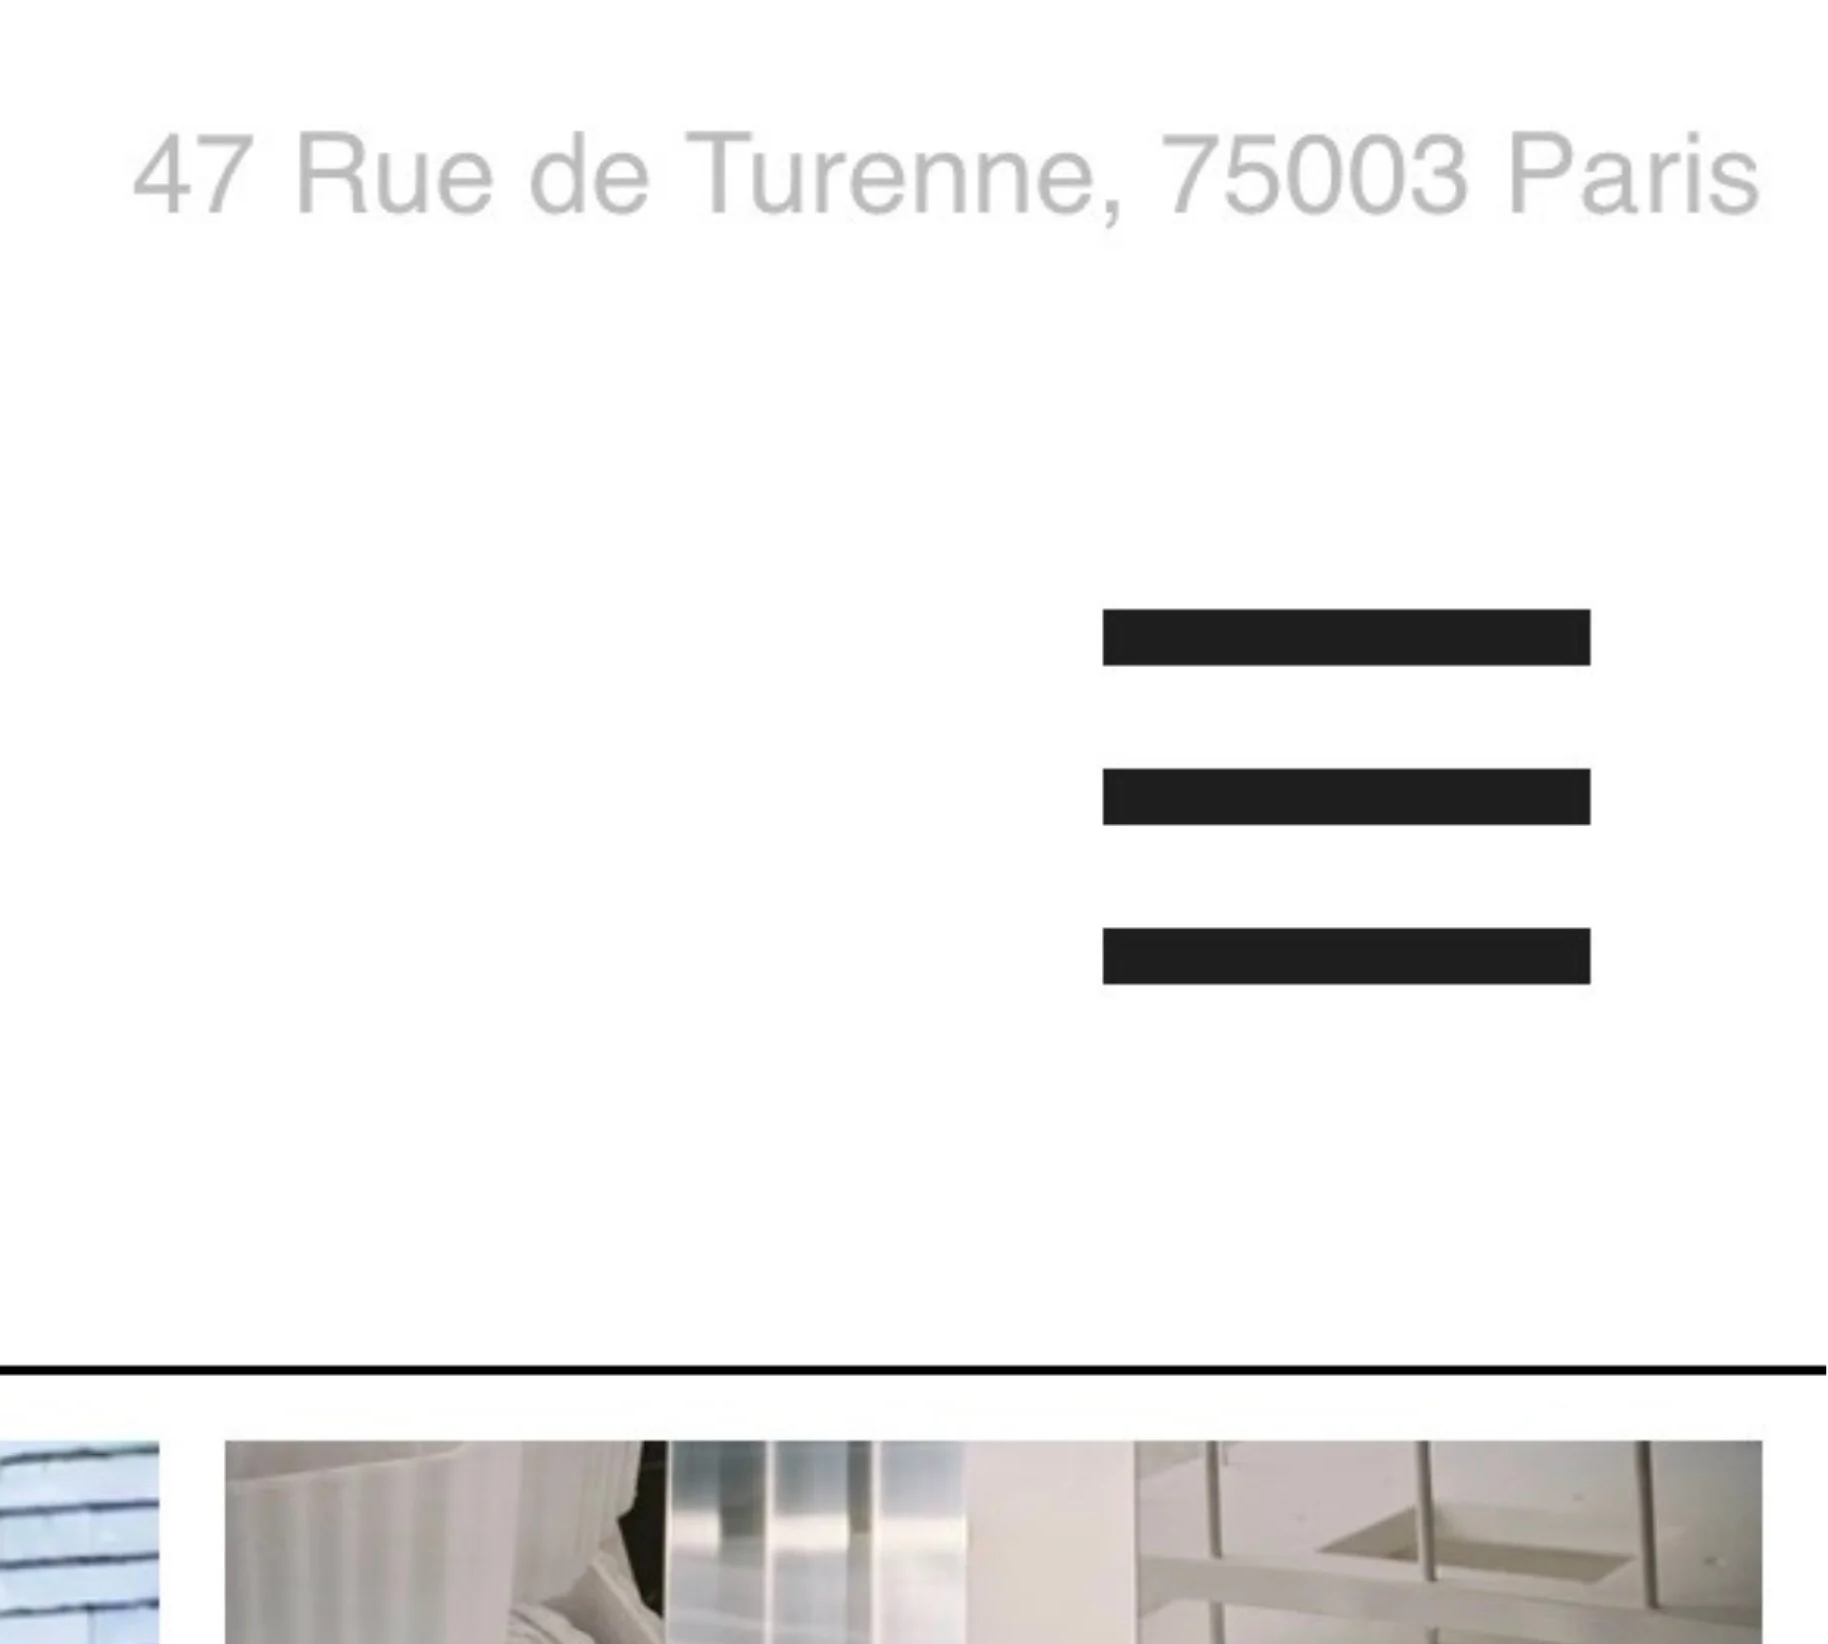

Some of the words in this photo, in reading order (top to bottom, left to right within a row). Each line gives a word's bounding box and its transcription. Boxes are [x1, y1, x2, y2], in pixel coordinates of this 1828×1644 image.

[135, 134, 252, 212] 47
[300, 132, 492, 214] Rue
[531, 131, 647, 214] de
[687, 132, 1118, 228] Turenne,
[1164, 134, 1466, 215] 75003
[1513, 132, 1758, 215] Paris
